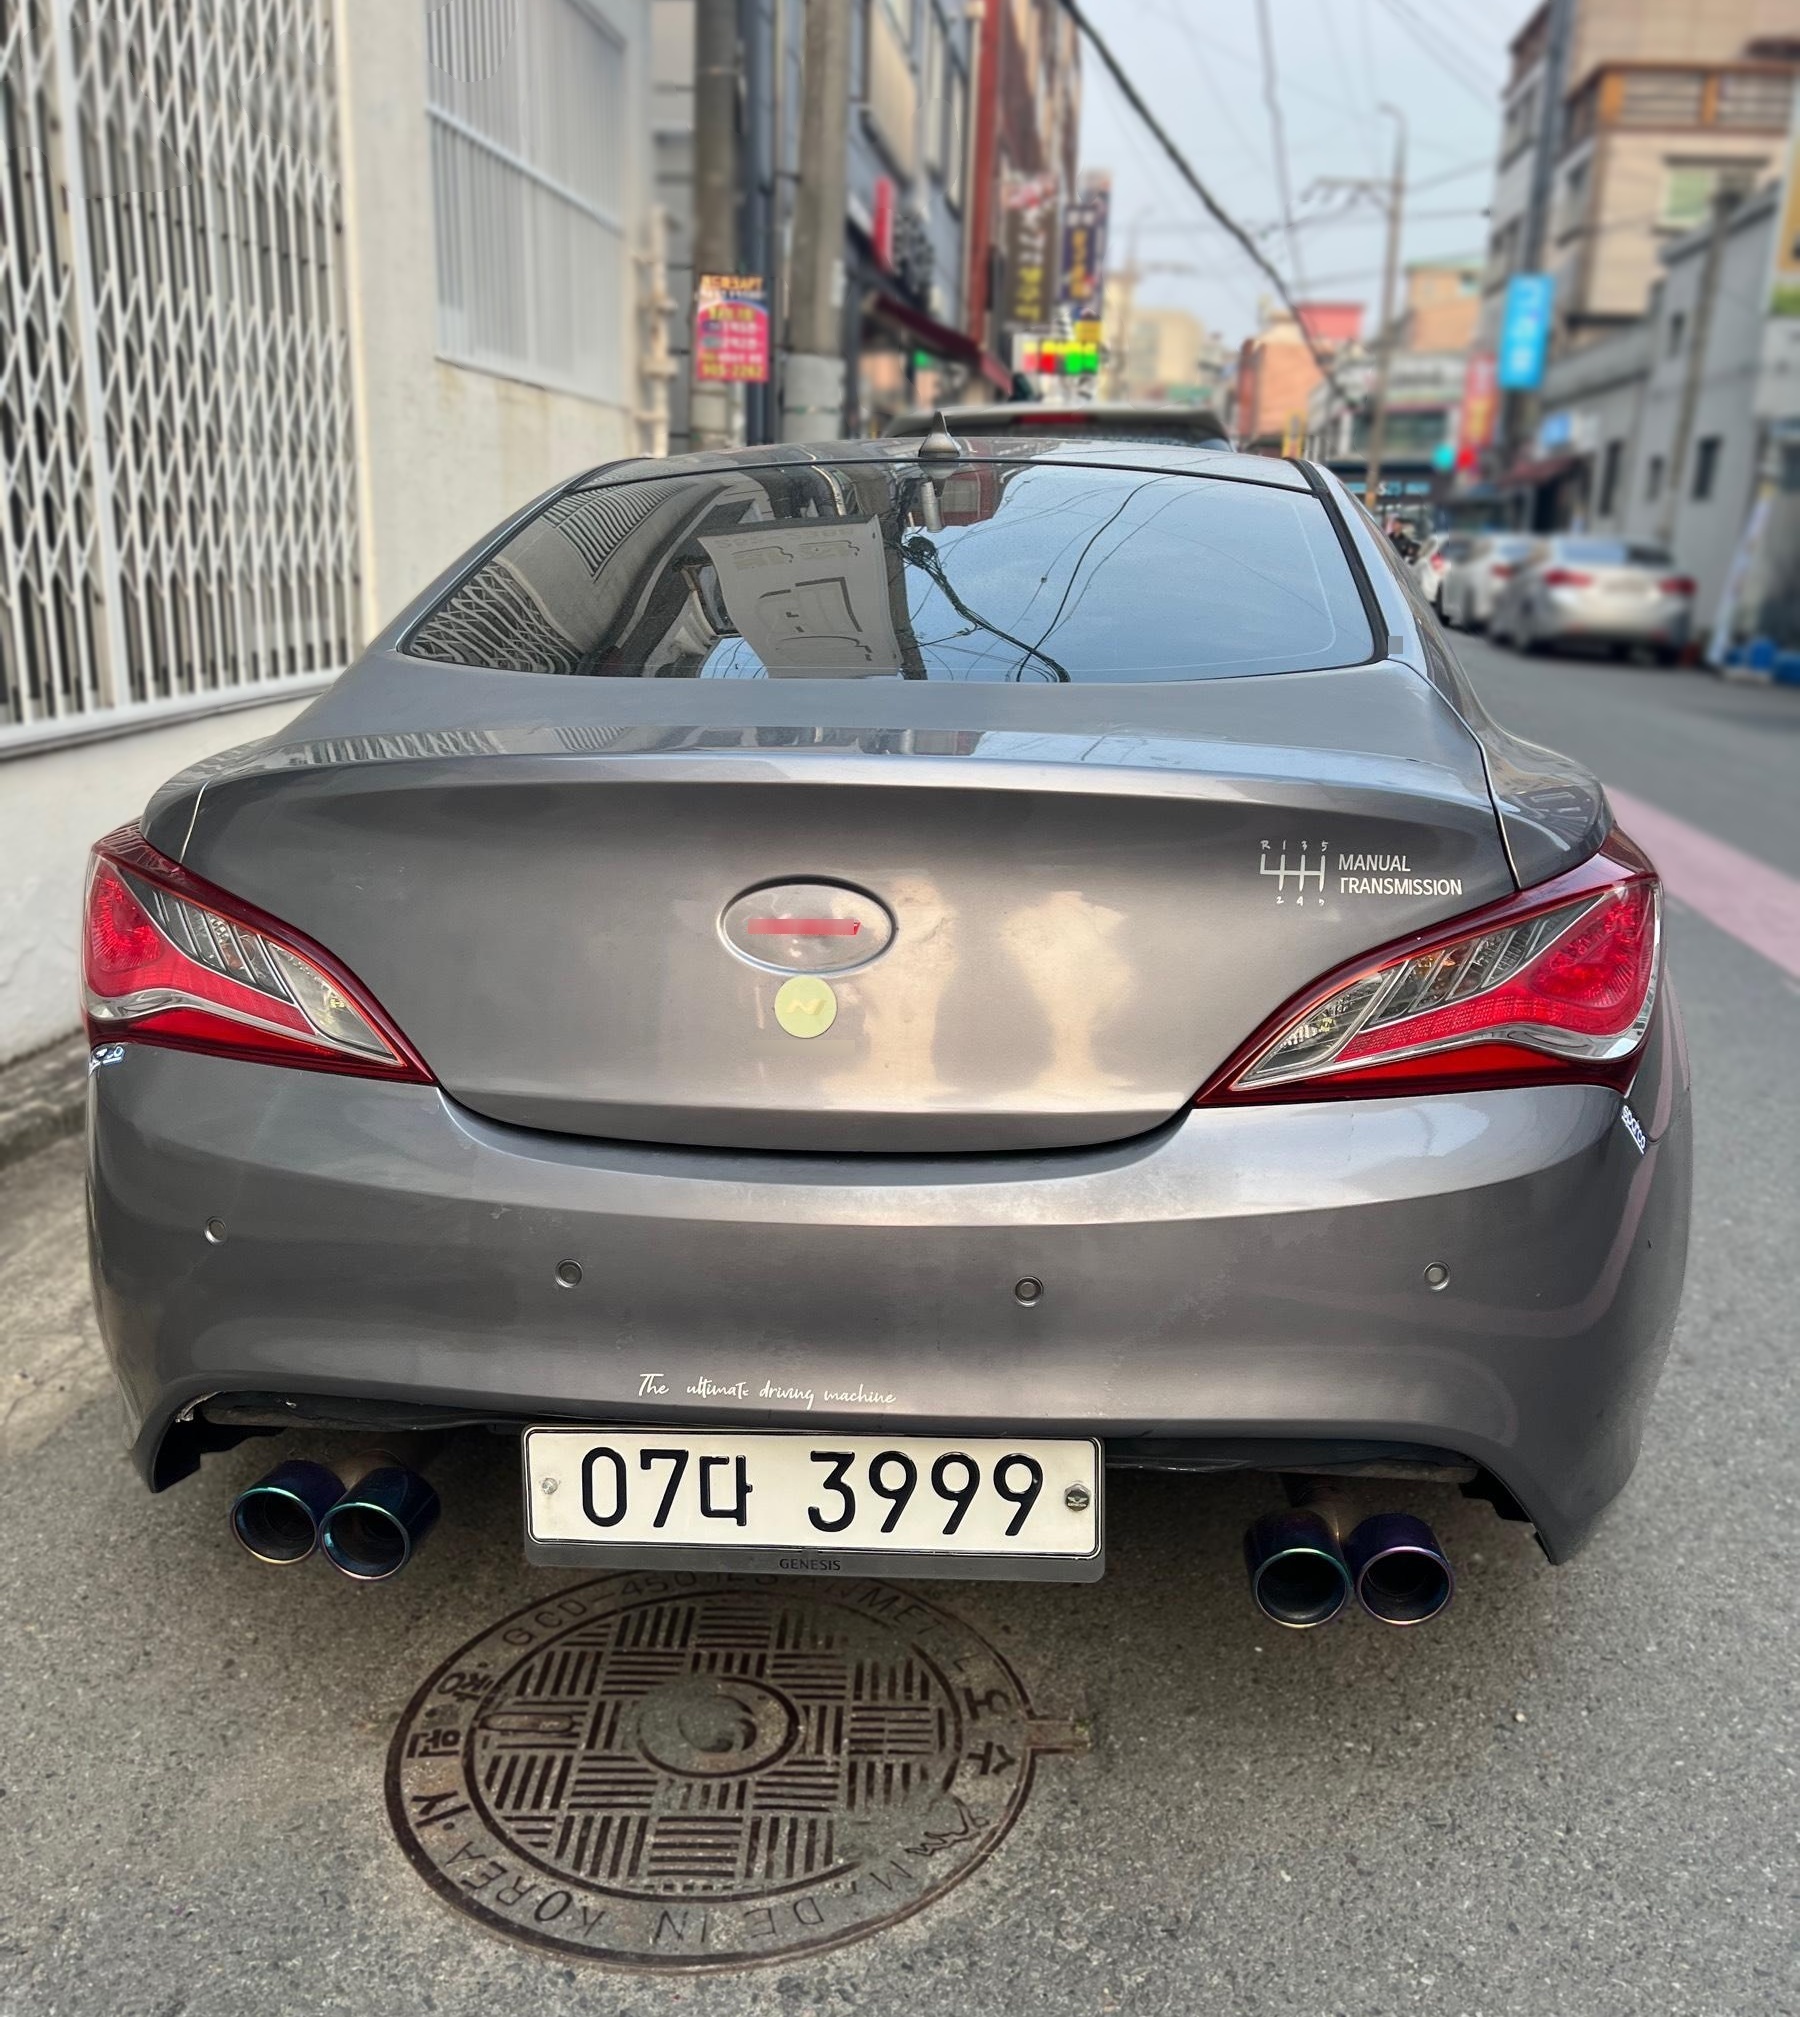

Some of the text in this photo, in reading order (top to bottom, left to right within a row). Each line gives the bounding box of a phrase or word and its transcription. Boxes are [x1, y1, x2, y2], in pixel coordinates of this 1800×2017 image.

[1260, 840, 1271, 850] R
[1301, 840, 1308, 852] 3
[1321, 840, 1328, 852] 5
[1338, 853, 1411, 872] MANUAL
[1340, 877, 1463, 896] TRANSMISSION
[1276, 896, 1284, 904] 2
[638, 1373, 897, 1411] The ultimate driving machine
[581, 1446, 1044, 1537] 07다 3999
[779, 1558, 842, 1571] GENESIS
[445, 1841, 606, 1937] KOREA
